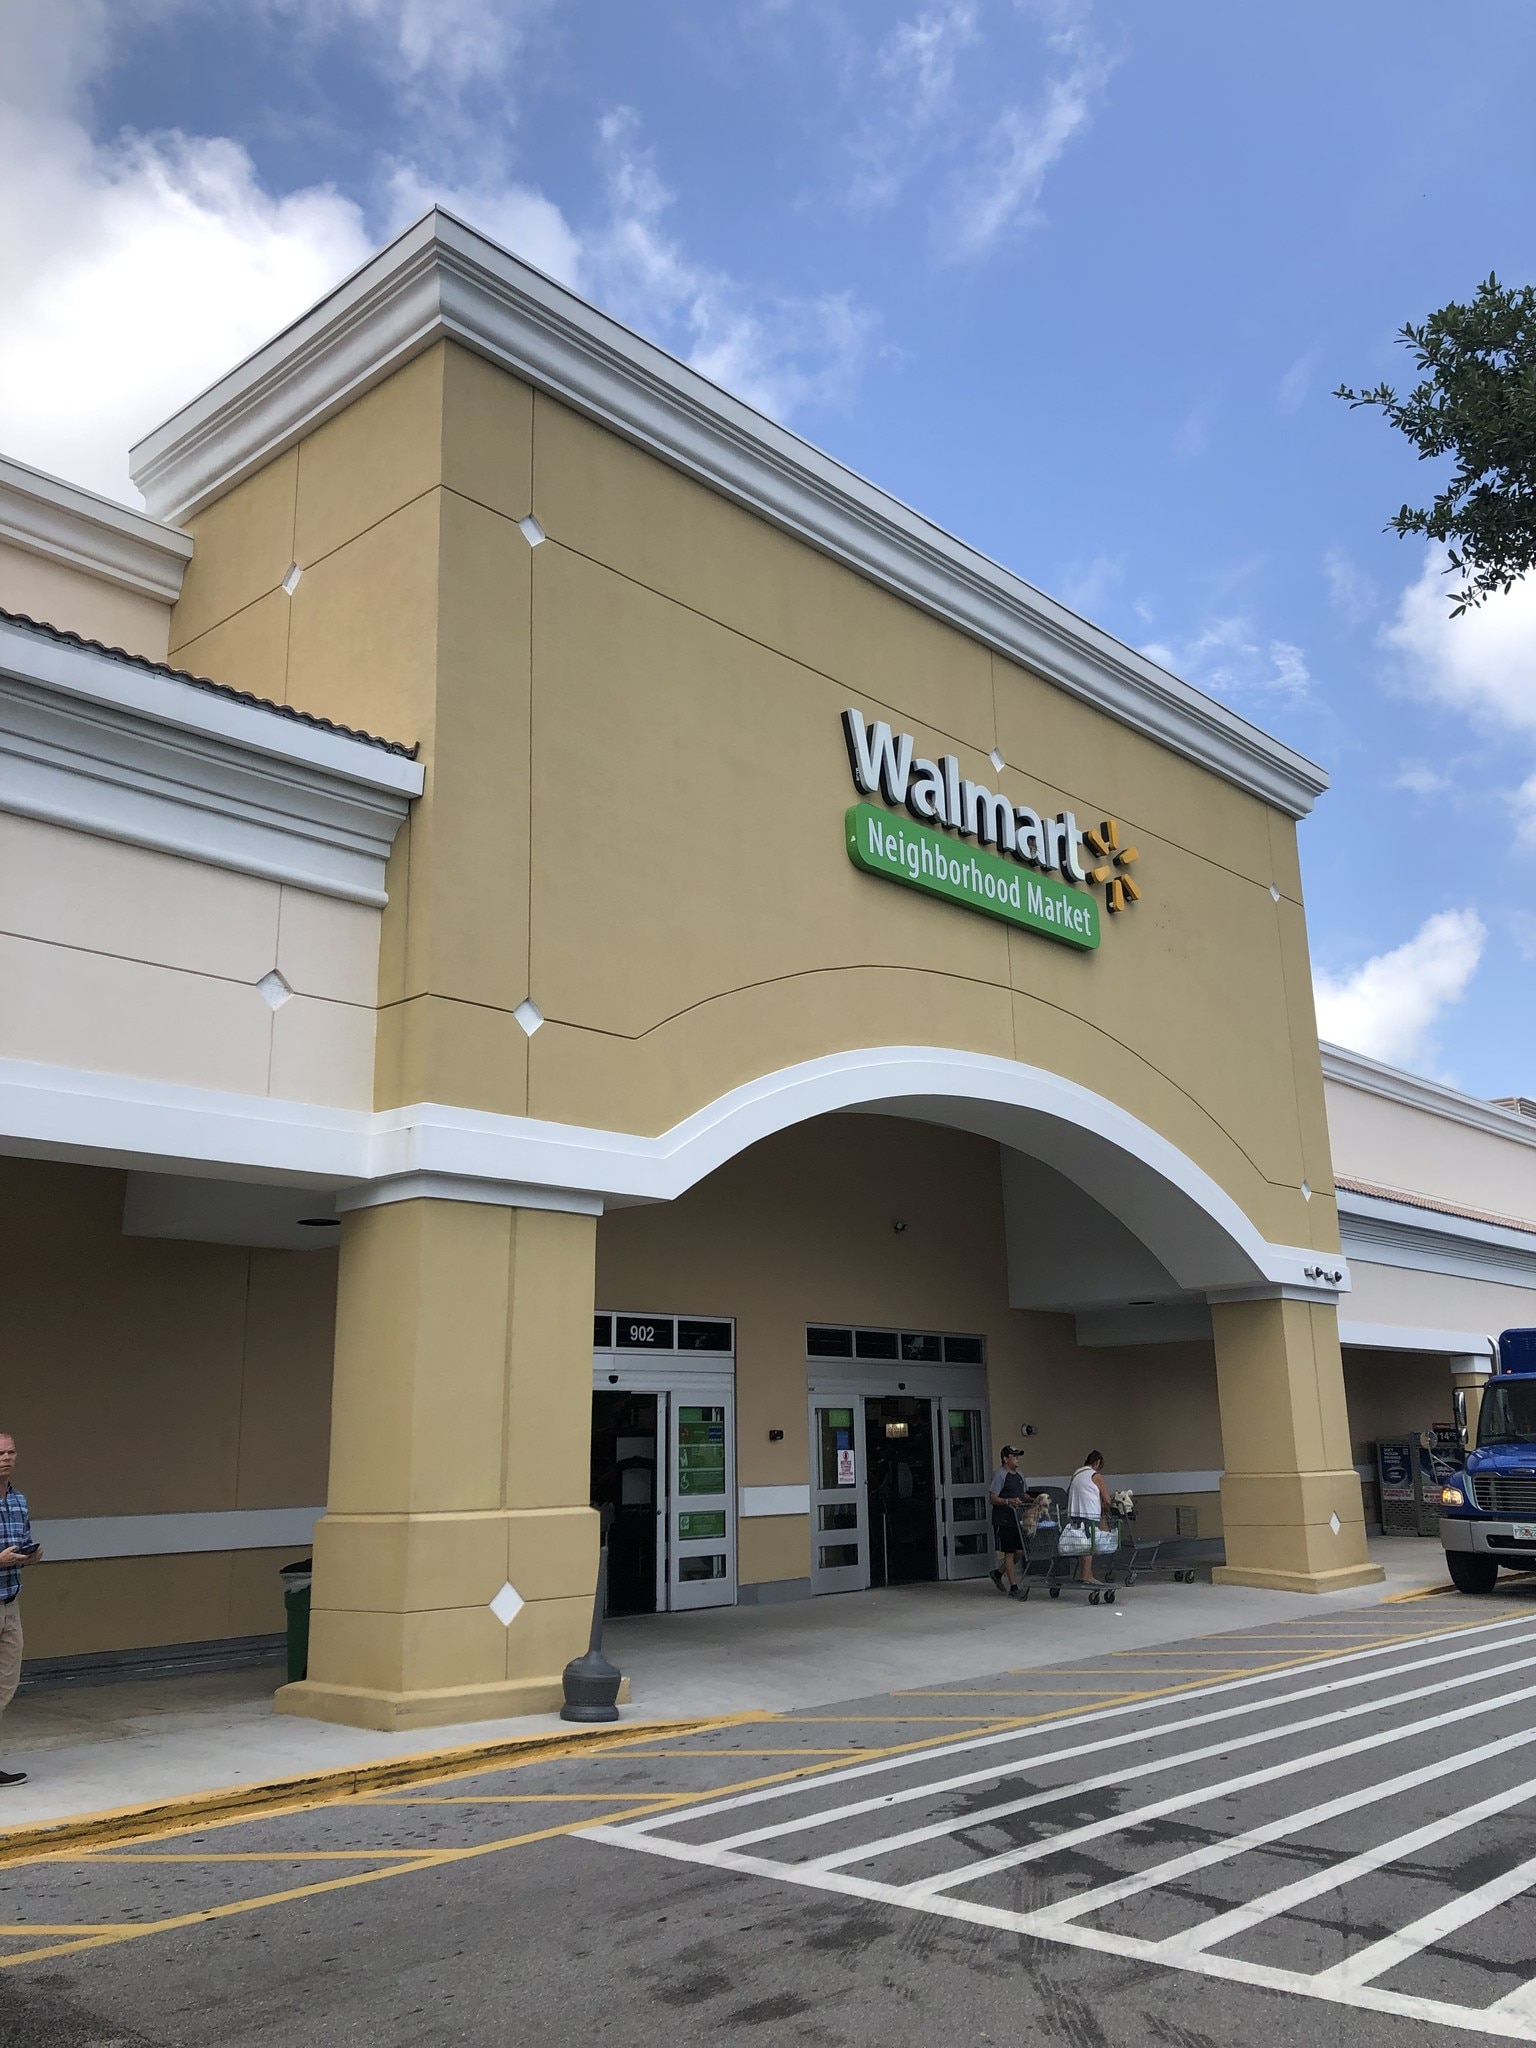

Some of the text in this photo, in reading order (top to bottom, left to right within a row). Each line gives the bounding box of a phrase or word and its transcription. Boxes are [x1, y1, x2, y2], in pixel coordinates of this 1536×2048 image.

[841, 707, 1085, 882] Walmart
[867, 817, 1092, 937] Neighborhood Market
[630, 1325, 655, 1342] 902
